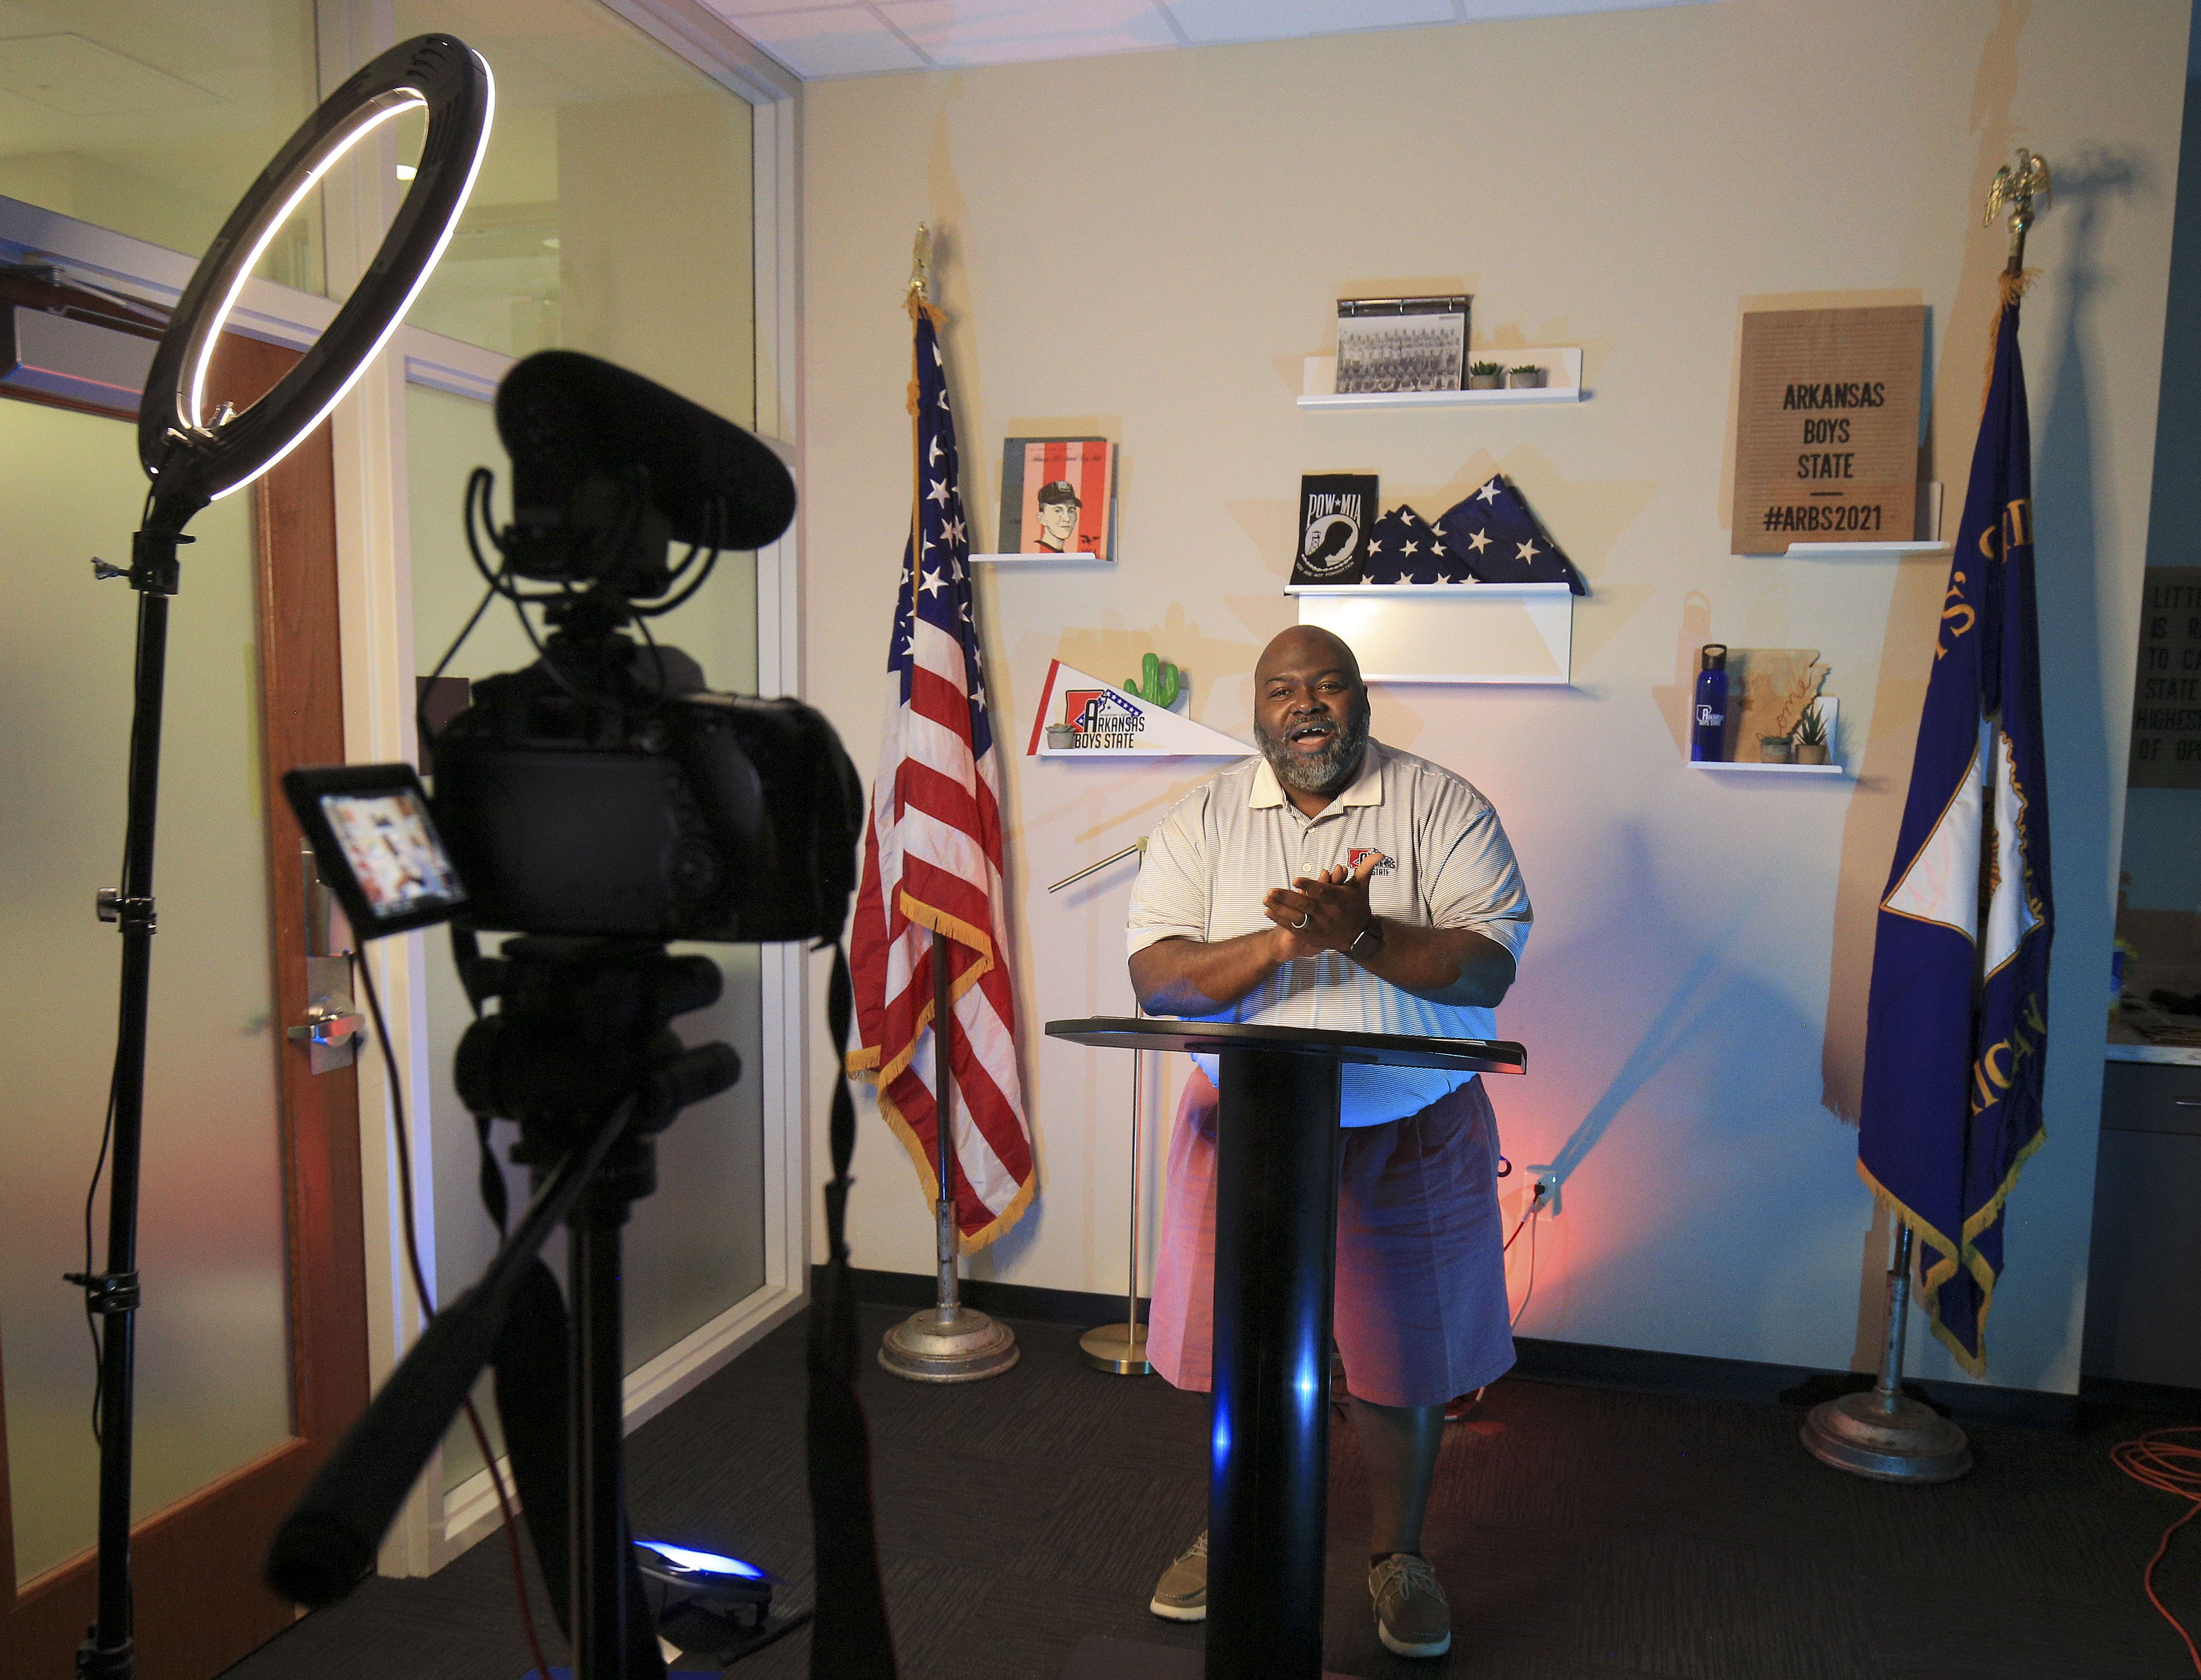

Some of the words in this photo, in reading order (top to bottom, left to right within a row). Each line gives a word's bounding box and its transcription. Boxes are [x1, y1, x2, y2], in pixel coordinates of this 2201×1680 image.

[1783, 382, 1885, 410] ARKANSAS
[1804, 419, 1851, 445] BOYS
[1797, 453, 1855, 480] STATE
[1306, 493, 1336, 530] POW
[1340, 493, 1360, 529] MIA
[1763, 505, 1882, 532] #ARBS2021
[2149, 647, 2169, 670] TO
[2145, 678, 2199, 700] STATE
[1084, 699, 1145, 733] ARKANSAS
[1075, 733, 1101, 748] BOYS
[1104, 733, 1135, 748] STATE
[2139, 738, 2162, 761] OF
